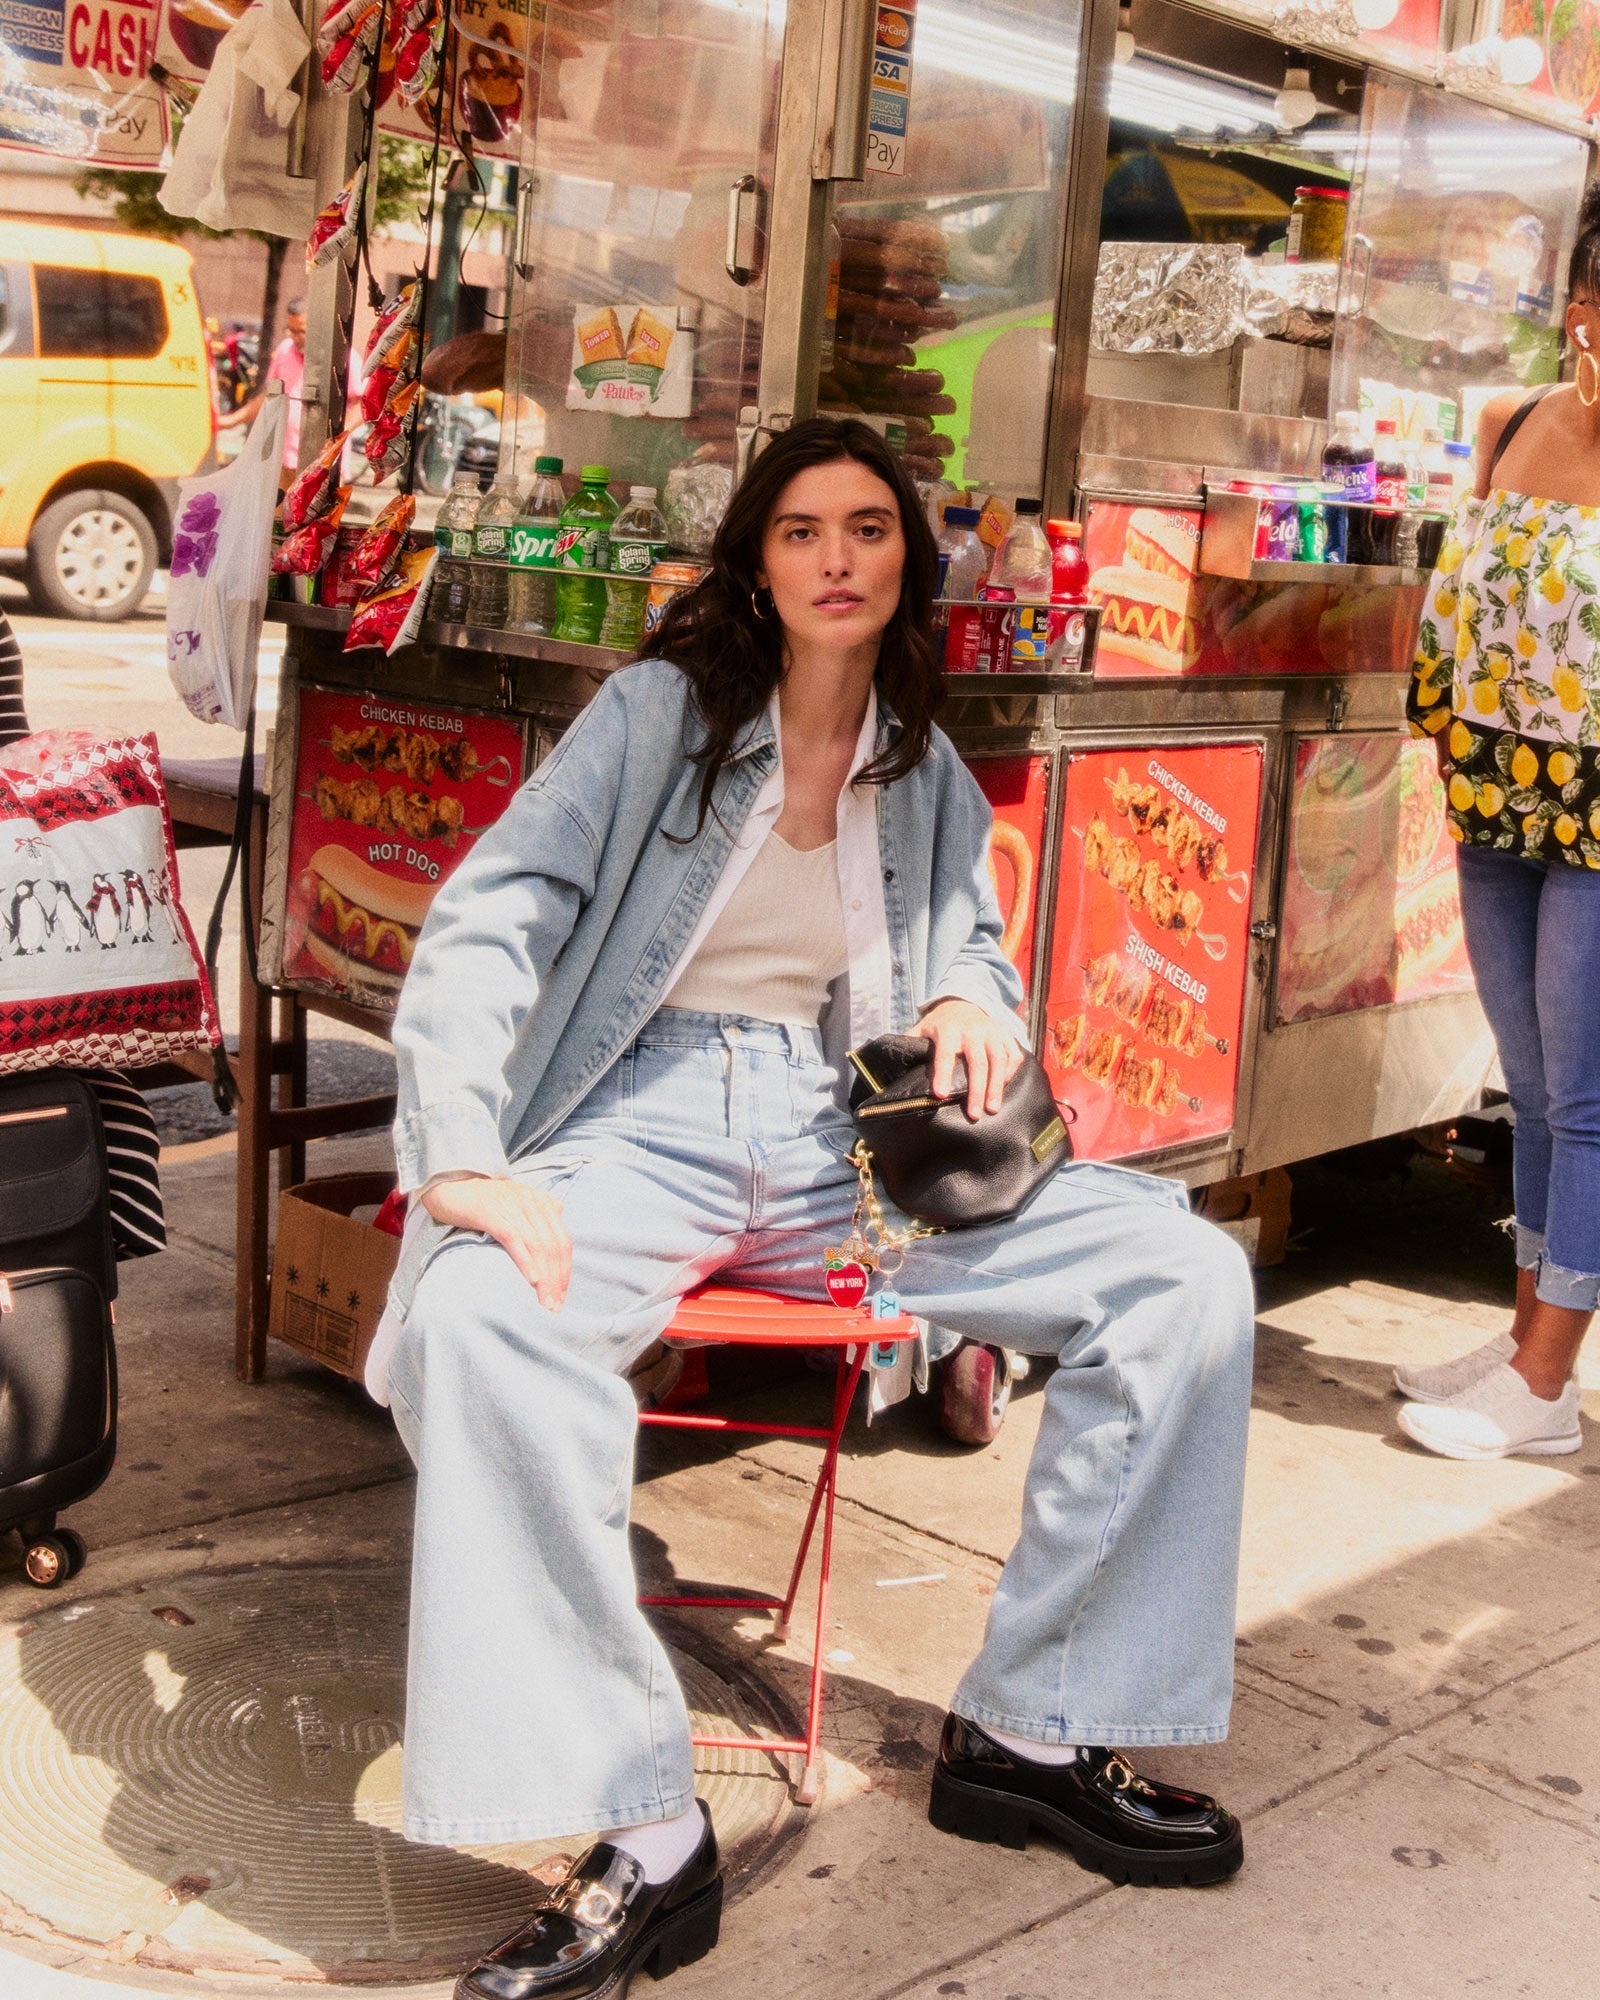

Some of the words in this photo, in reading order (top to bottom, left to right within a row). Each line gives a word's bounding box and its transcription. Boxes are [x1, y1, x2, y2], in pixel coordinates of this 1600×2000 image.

[0, 3, 60, 29] MERICAN
[3, 23, 65, 50] EXPRESS
[876, 21, 909, 38] terCard
[873, 61, 900, 81] ISA
[870, 99, 901, 116] ERICAN
[104, 107, 148, 141] Pay
[870, 114, 904, 128] XPRESS
[866, 133, 900, 171] Pay
[602, 382, 646, 400] Patties
[476, 528, 505, 542] Poland
[1187, 524, 1202, 544] DO
[477, 538, 506, 551] Spring
[511, 530, 557, 563] Spri
[618, 545, 650, 560] Poland
[619, 554, 651, 569] Spring
[359, 704, 416, 726] CHICKEN
[418, 714, 464, 733] KEBAB
[1146, 759, 1192, 808] CHICKEN
[1191, 797, 1228, 835] KEBAB
[368, 843, 402, 863] HOT
[405, 847, 440, 881] DOG
[1124, 935, 1163, 977] SHISH
[1162, 961, 1208, 1004] KEBAB
[829, 1278, 845, 1289] NEW
[845, 1277, 864, 1288] YORK
